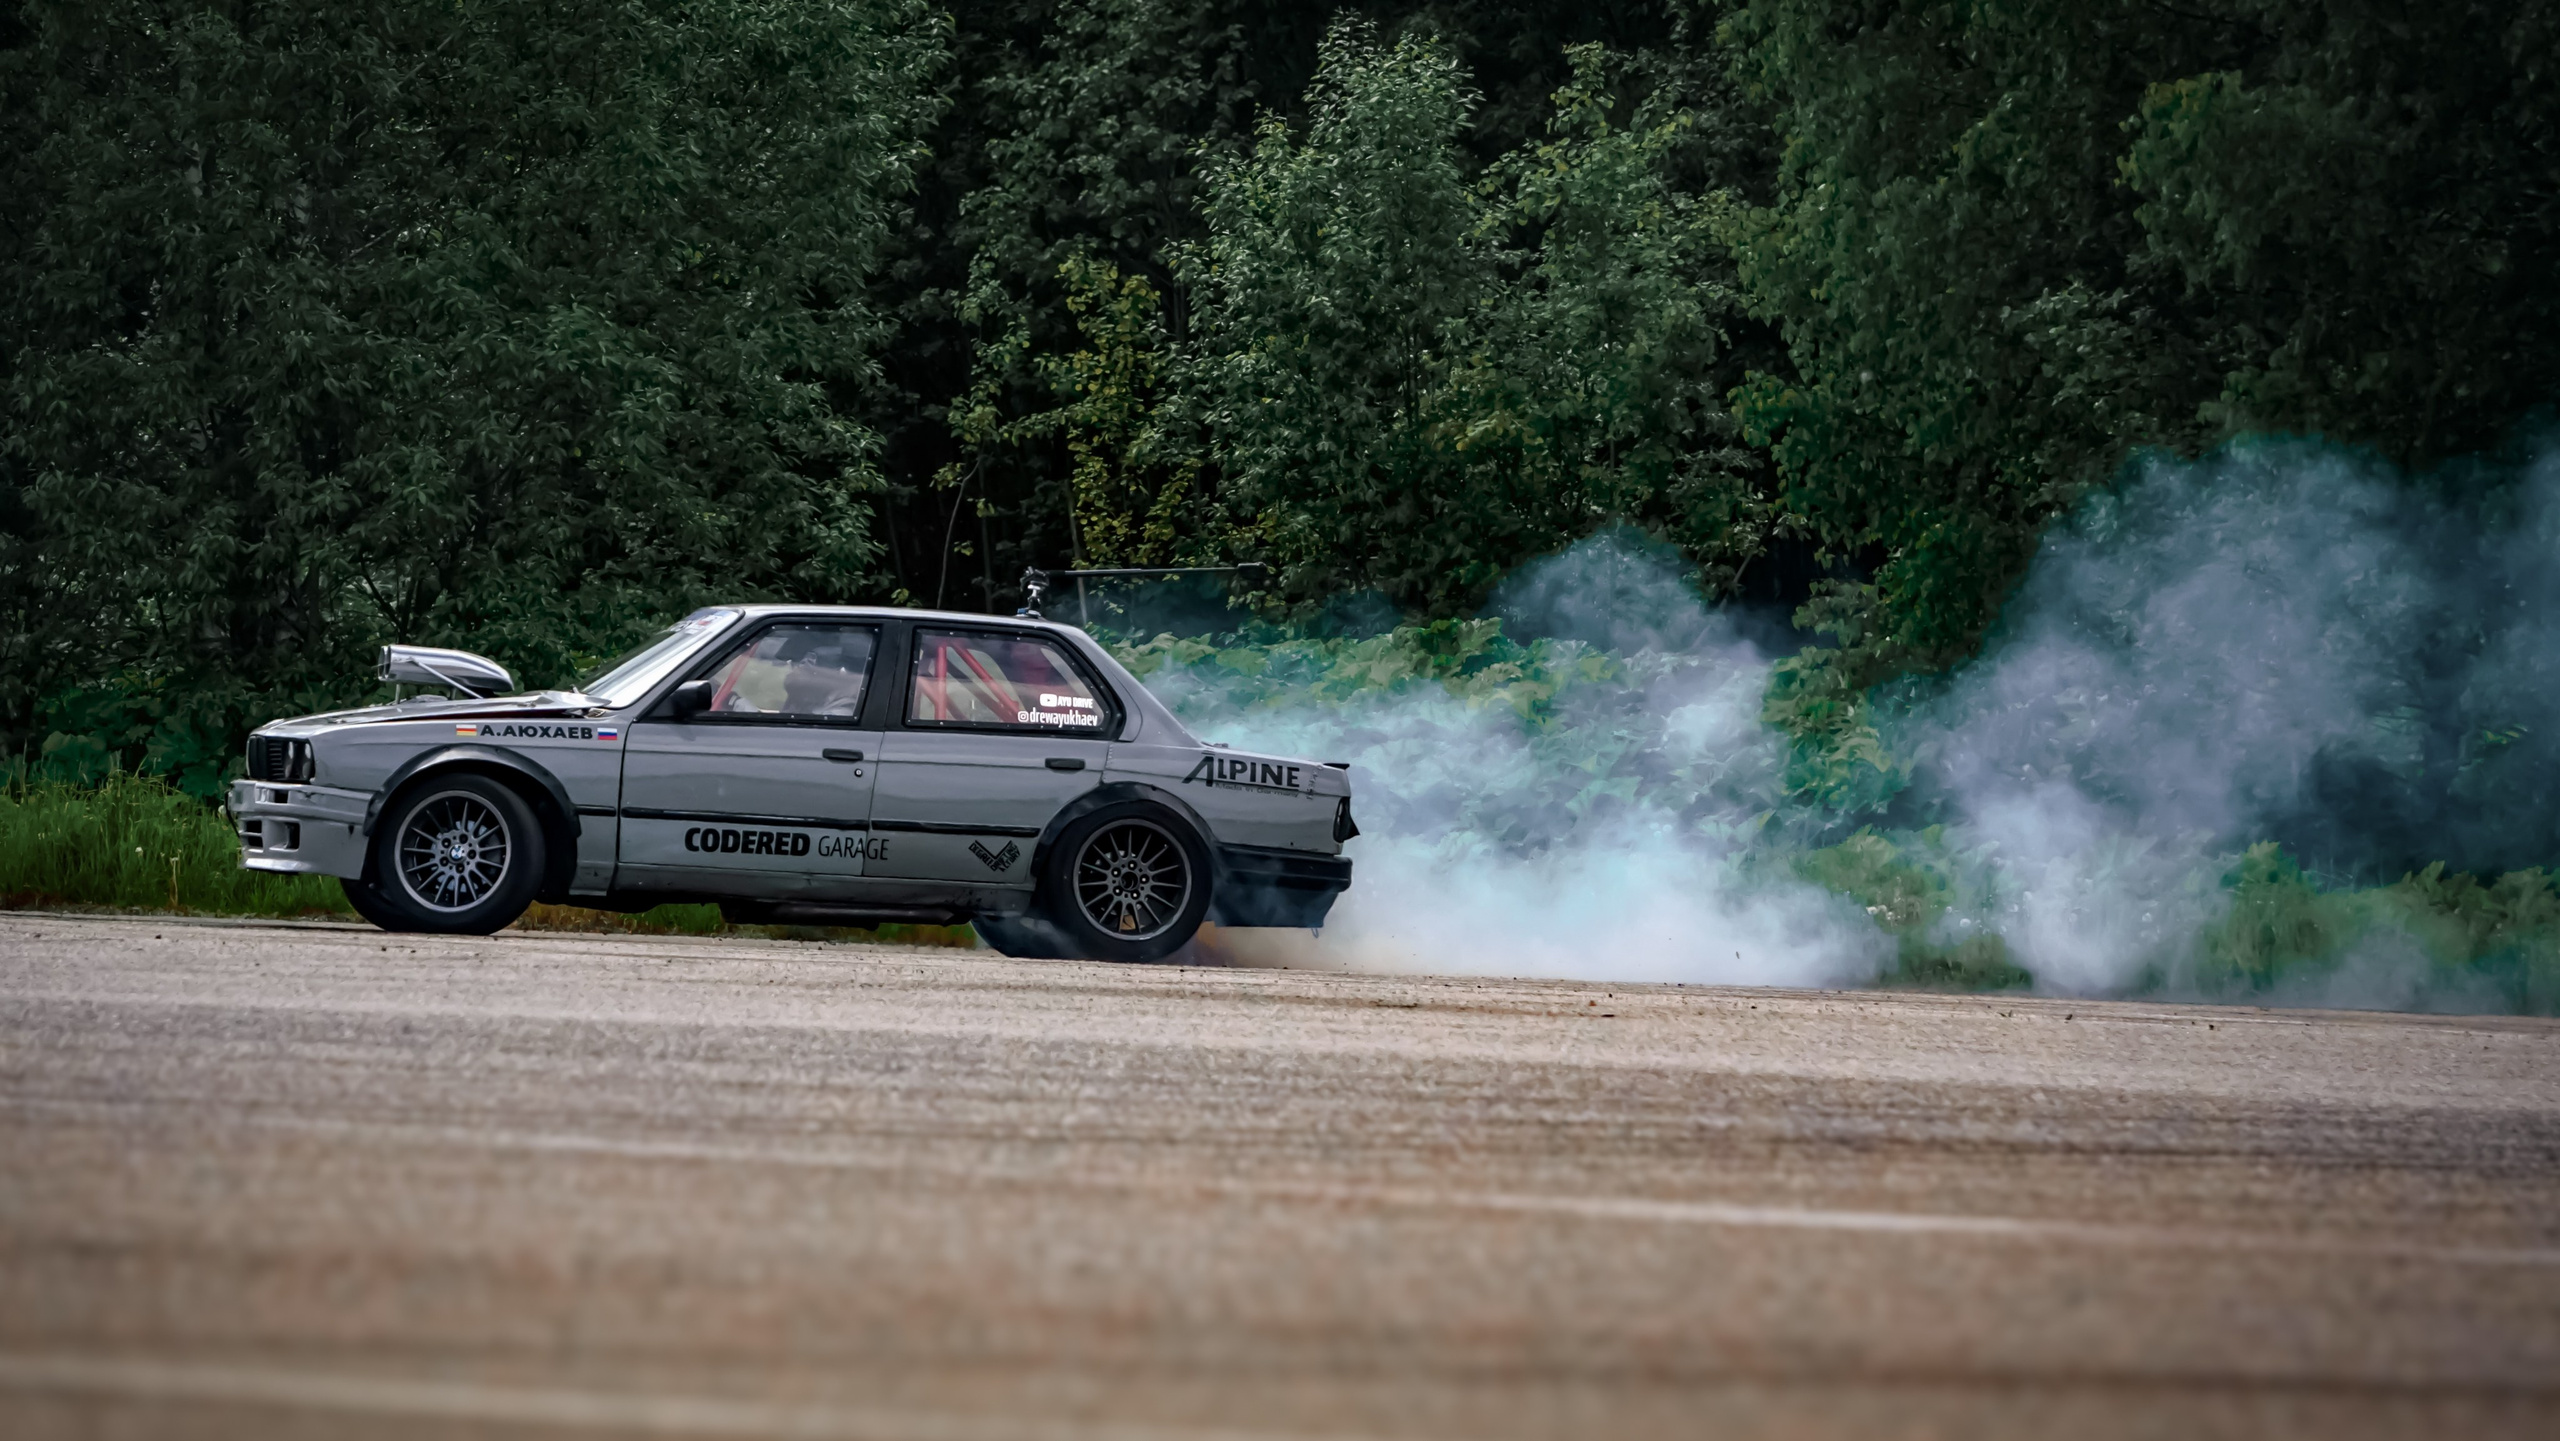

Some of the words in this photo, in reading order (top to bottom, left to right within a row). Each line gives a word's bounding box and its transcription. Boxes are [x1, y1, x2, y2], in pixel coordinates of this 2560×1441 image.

[1057, 696, 1072, 707] AYU
[1072, 697, 1093, 709] DRIVE
[1029, 707, 1098, 728] drewayukhaev
[480, 724, 593, 740] А.АЮХАЕВ
[1181, 753, 1300, 788] ALPINE
[684, 827, 811, 857] CODERED
[818, 835, 890, 861] GARAGE
